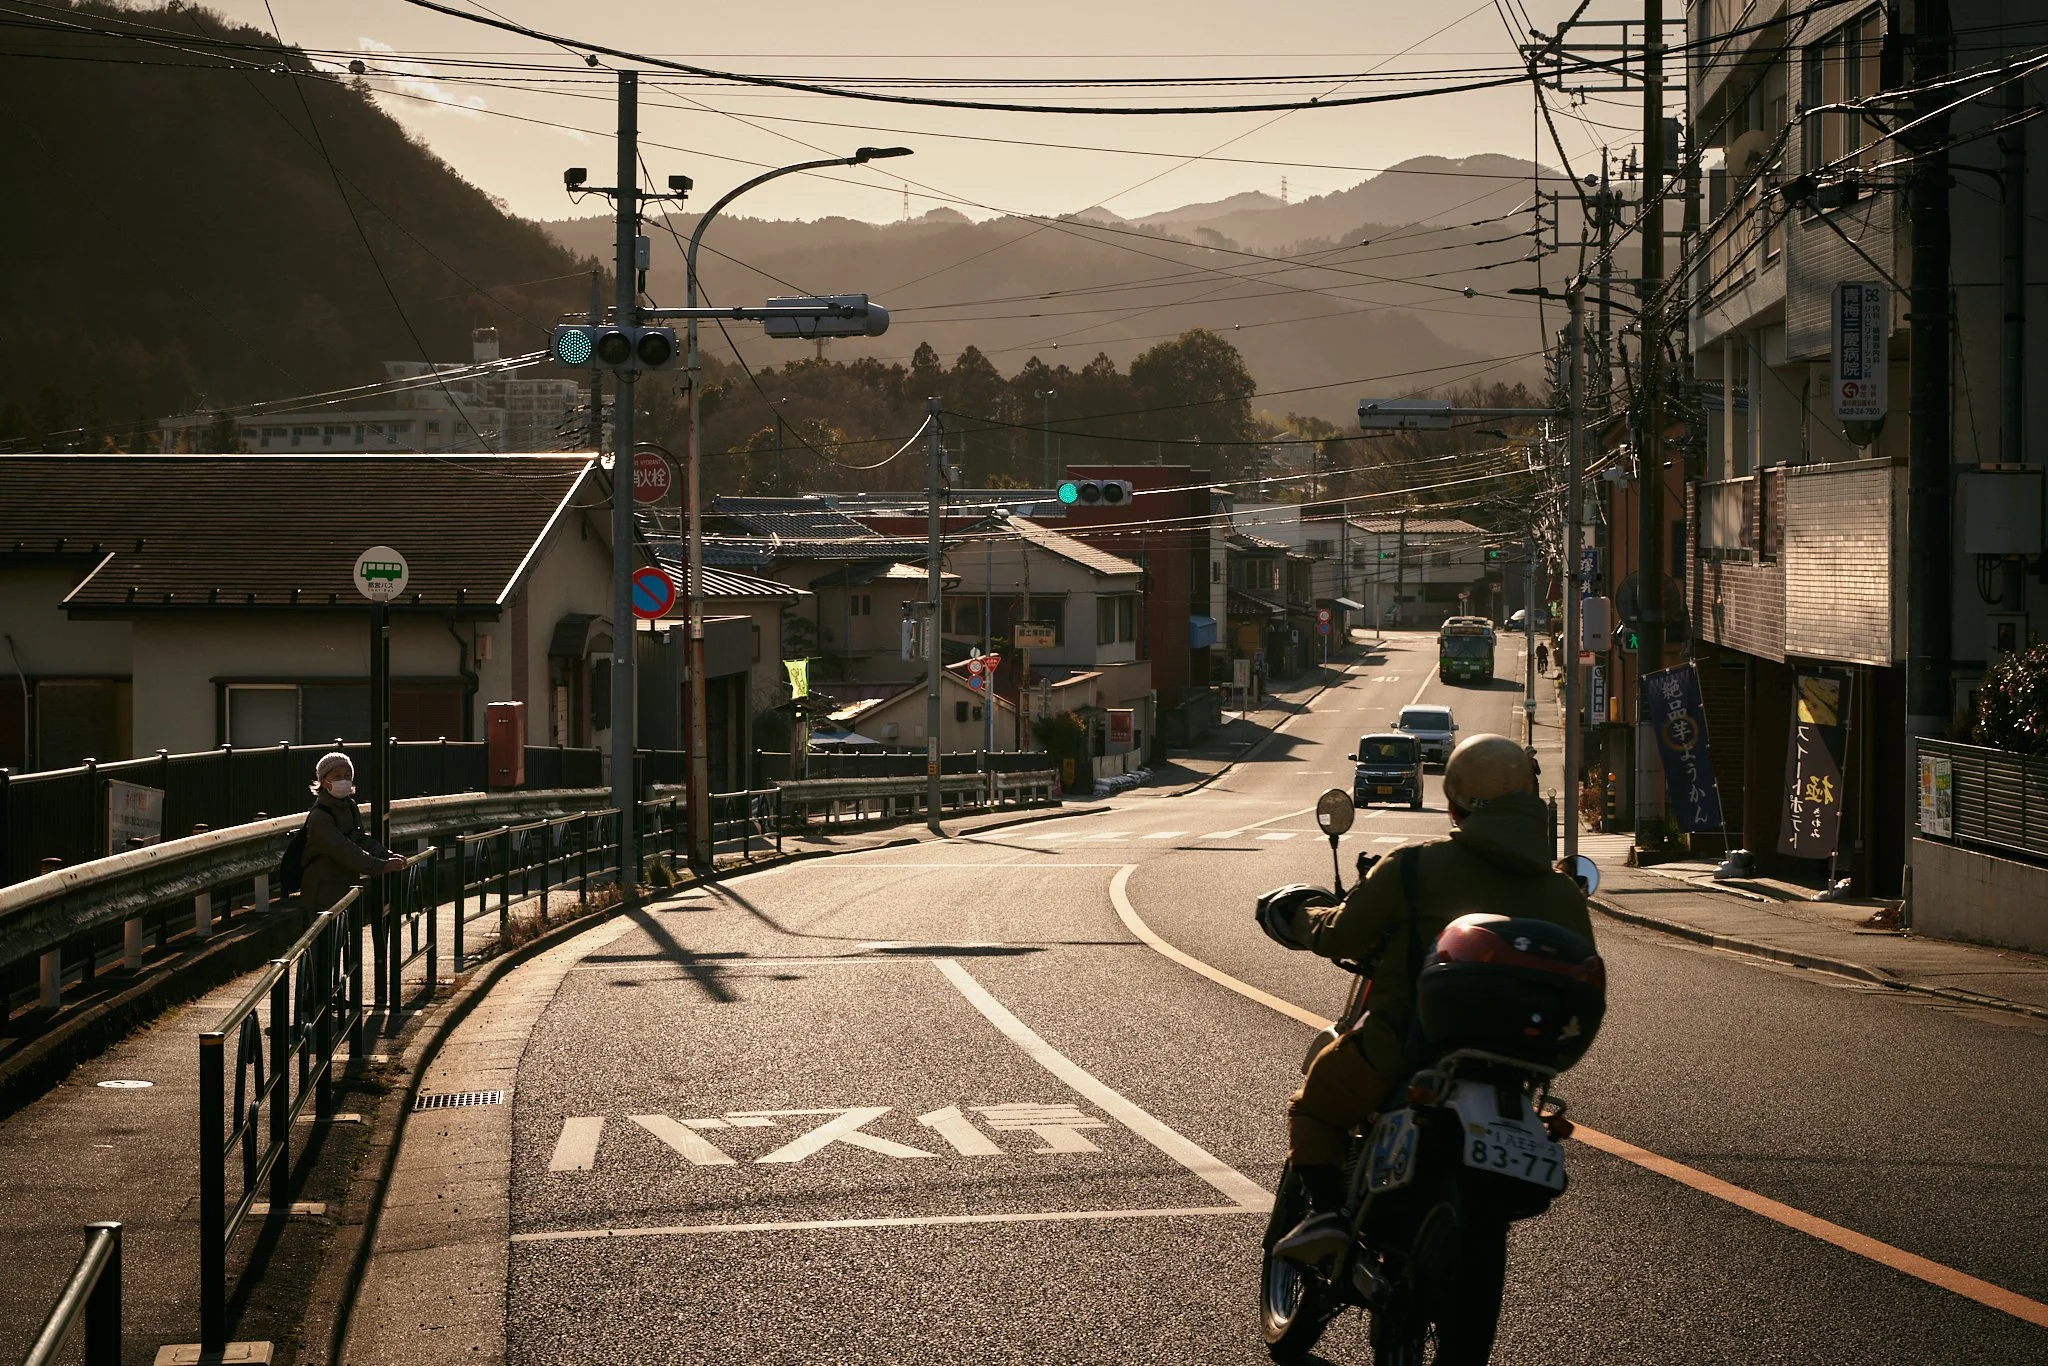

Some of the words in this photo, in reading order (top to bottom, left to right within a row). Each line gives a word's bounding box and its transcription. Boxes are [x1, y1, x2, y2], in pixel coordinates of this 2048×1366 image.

[1843, 287, 1861, 377] 青梅三慶病院
[1839, 407, 1880, 415] 0428-24-7501
[1662, 680, 1708, 824] 絶品芋ようかん
[548, 1103, 1107, 1172] バス停
[1471, 1139, 1559, 1182] 83-77
